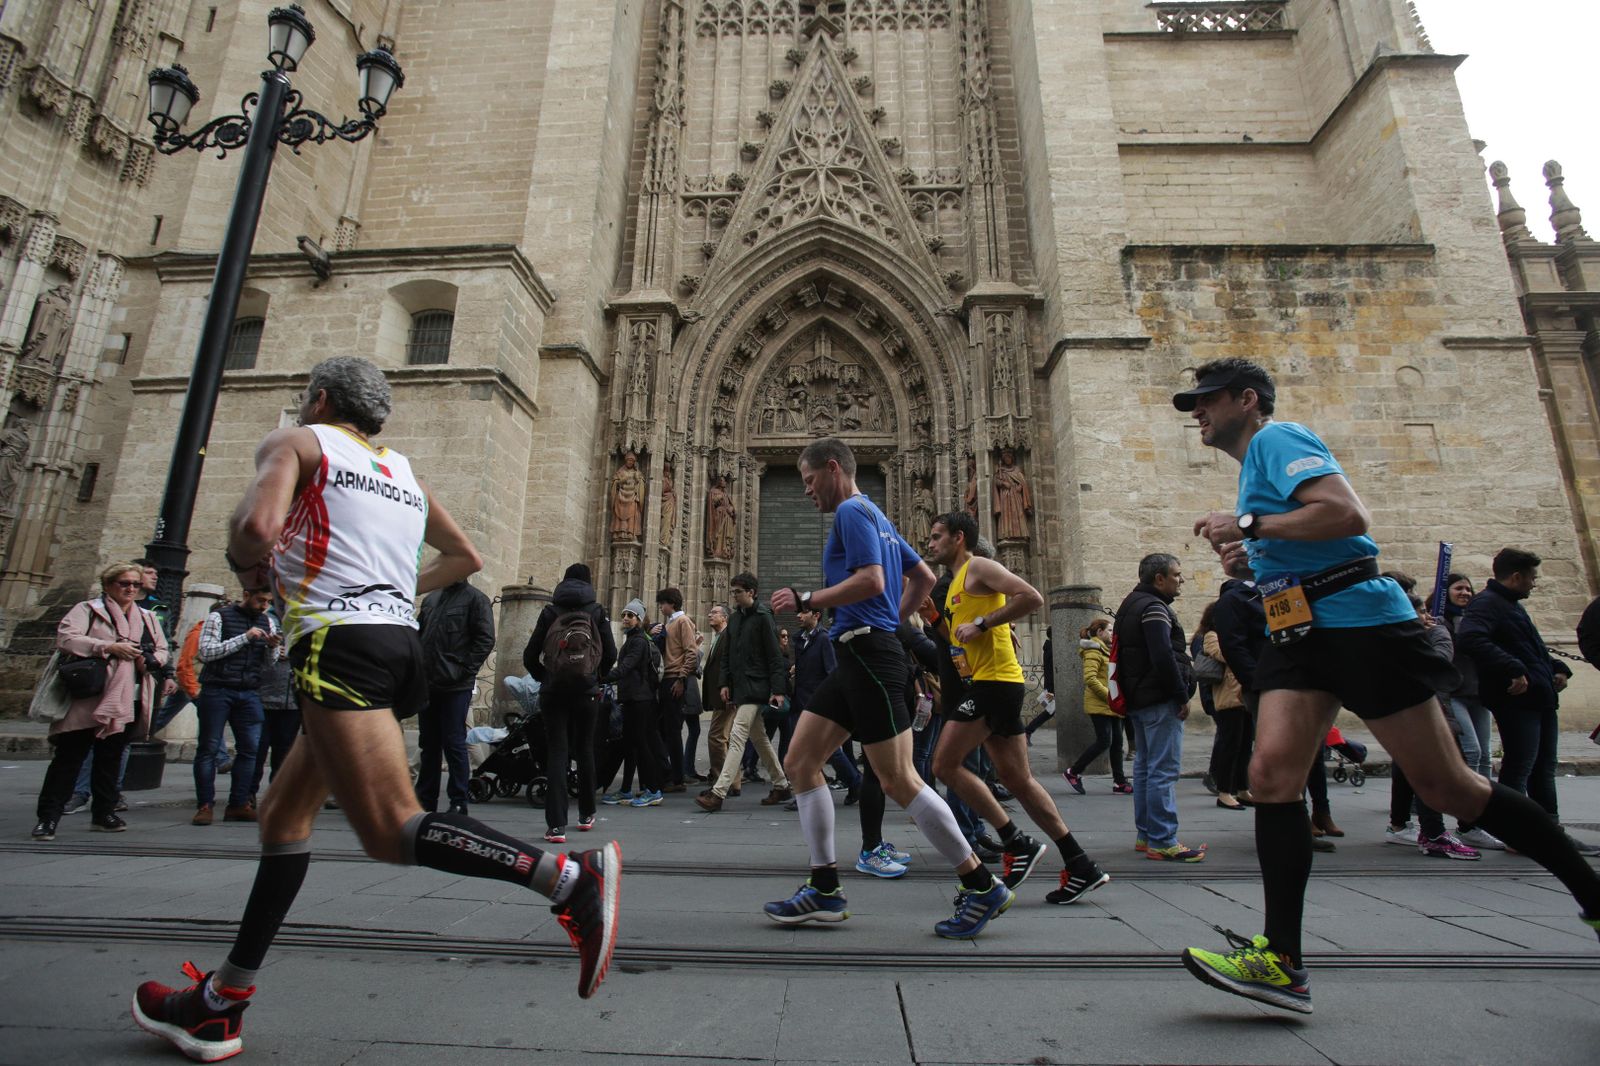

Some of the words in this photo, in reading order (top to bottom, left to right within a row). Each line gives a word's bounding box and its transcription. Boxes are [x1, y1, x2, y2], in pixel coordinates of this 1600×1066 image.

[333, 470, 401, 502] ARMANDO
[403, 489, 424, 512] DIAS
[1269, 599, 1291, 618] 4198
